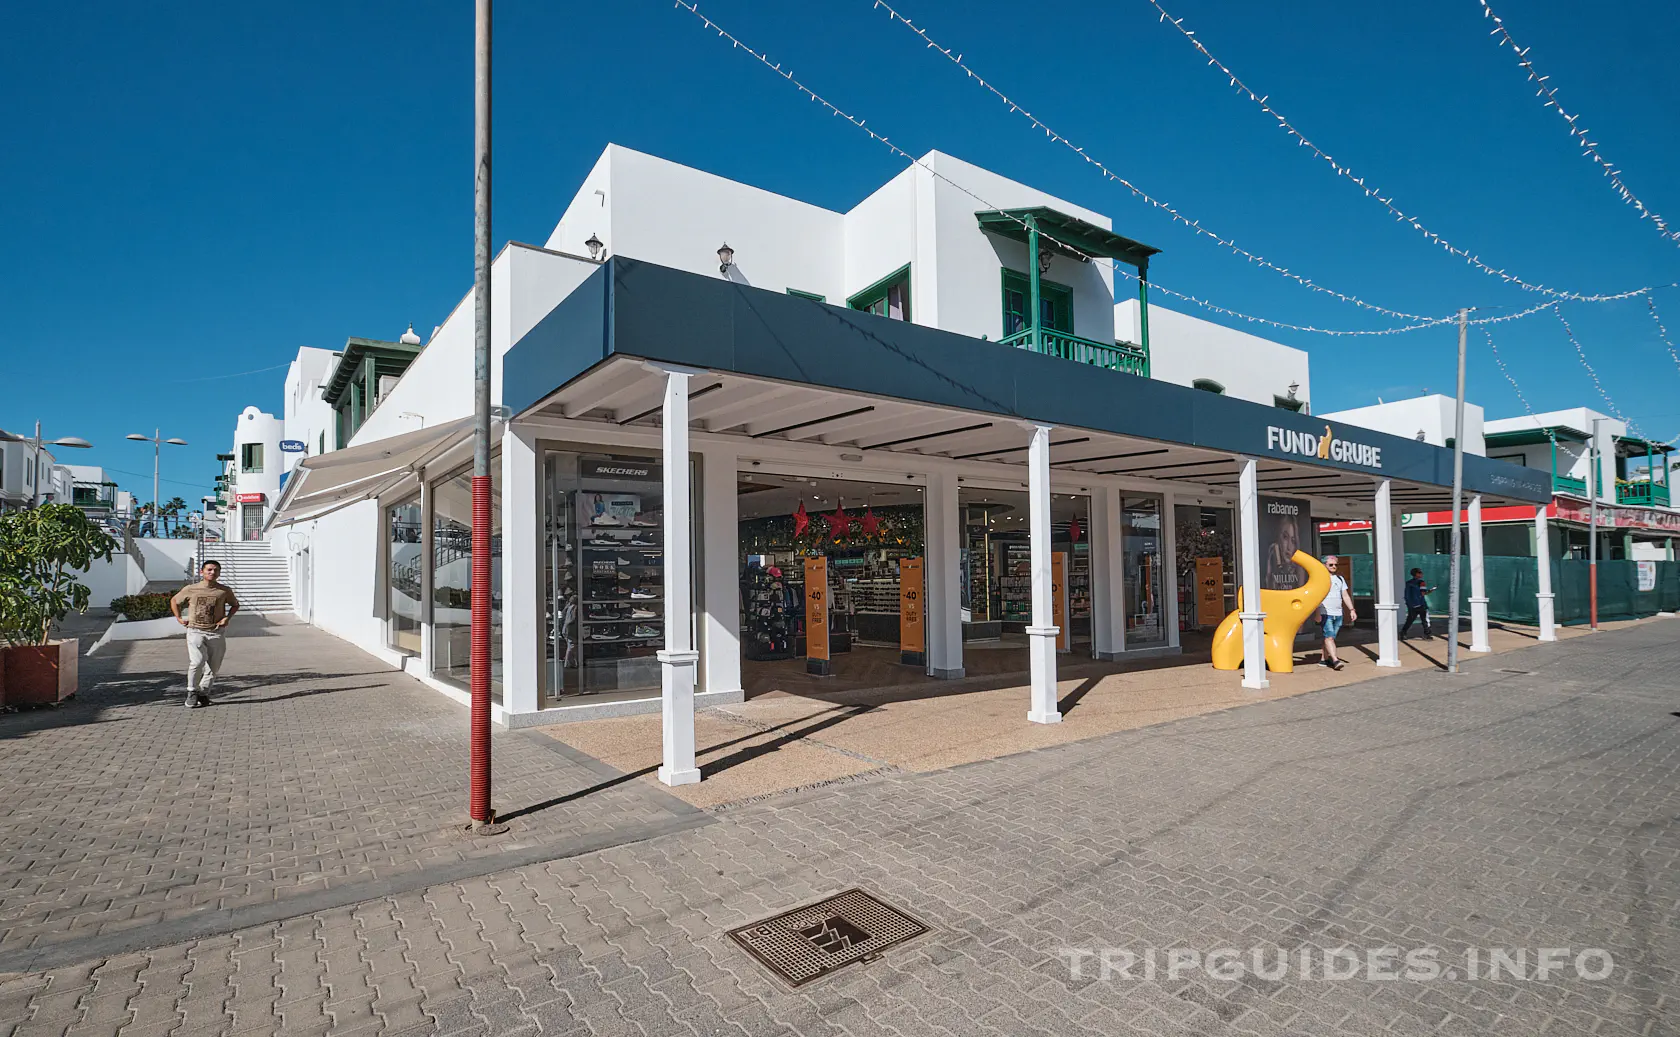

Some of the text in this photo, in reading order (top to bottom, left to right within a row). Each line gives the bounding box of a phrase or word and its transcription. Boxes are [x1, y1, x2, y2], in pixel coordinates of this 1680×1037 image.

[1267, 425, 1382, 469] FUND GRUBE
[595, 466, 649, 476] SKECHERS
[1267, 502, 1299, 515] rabanne
